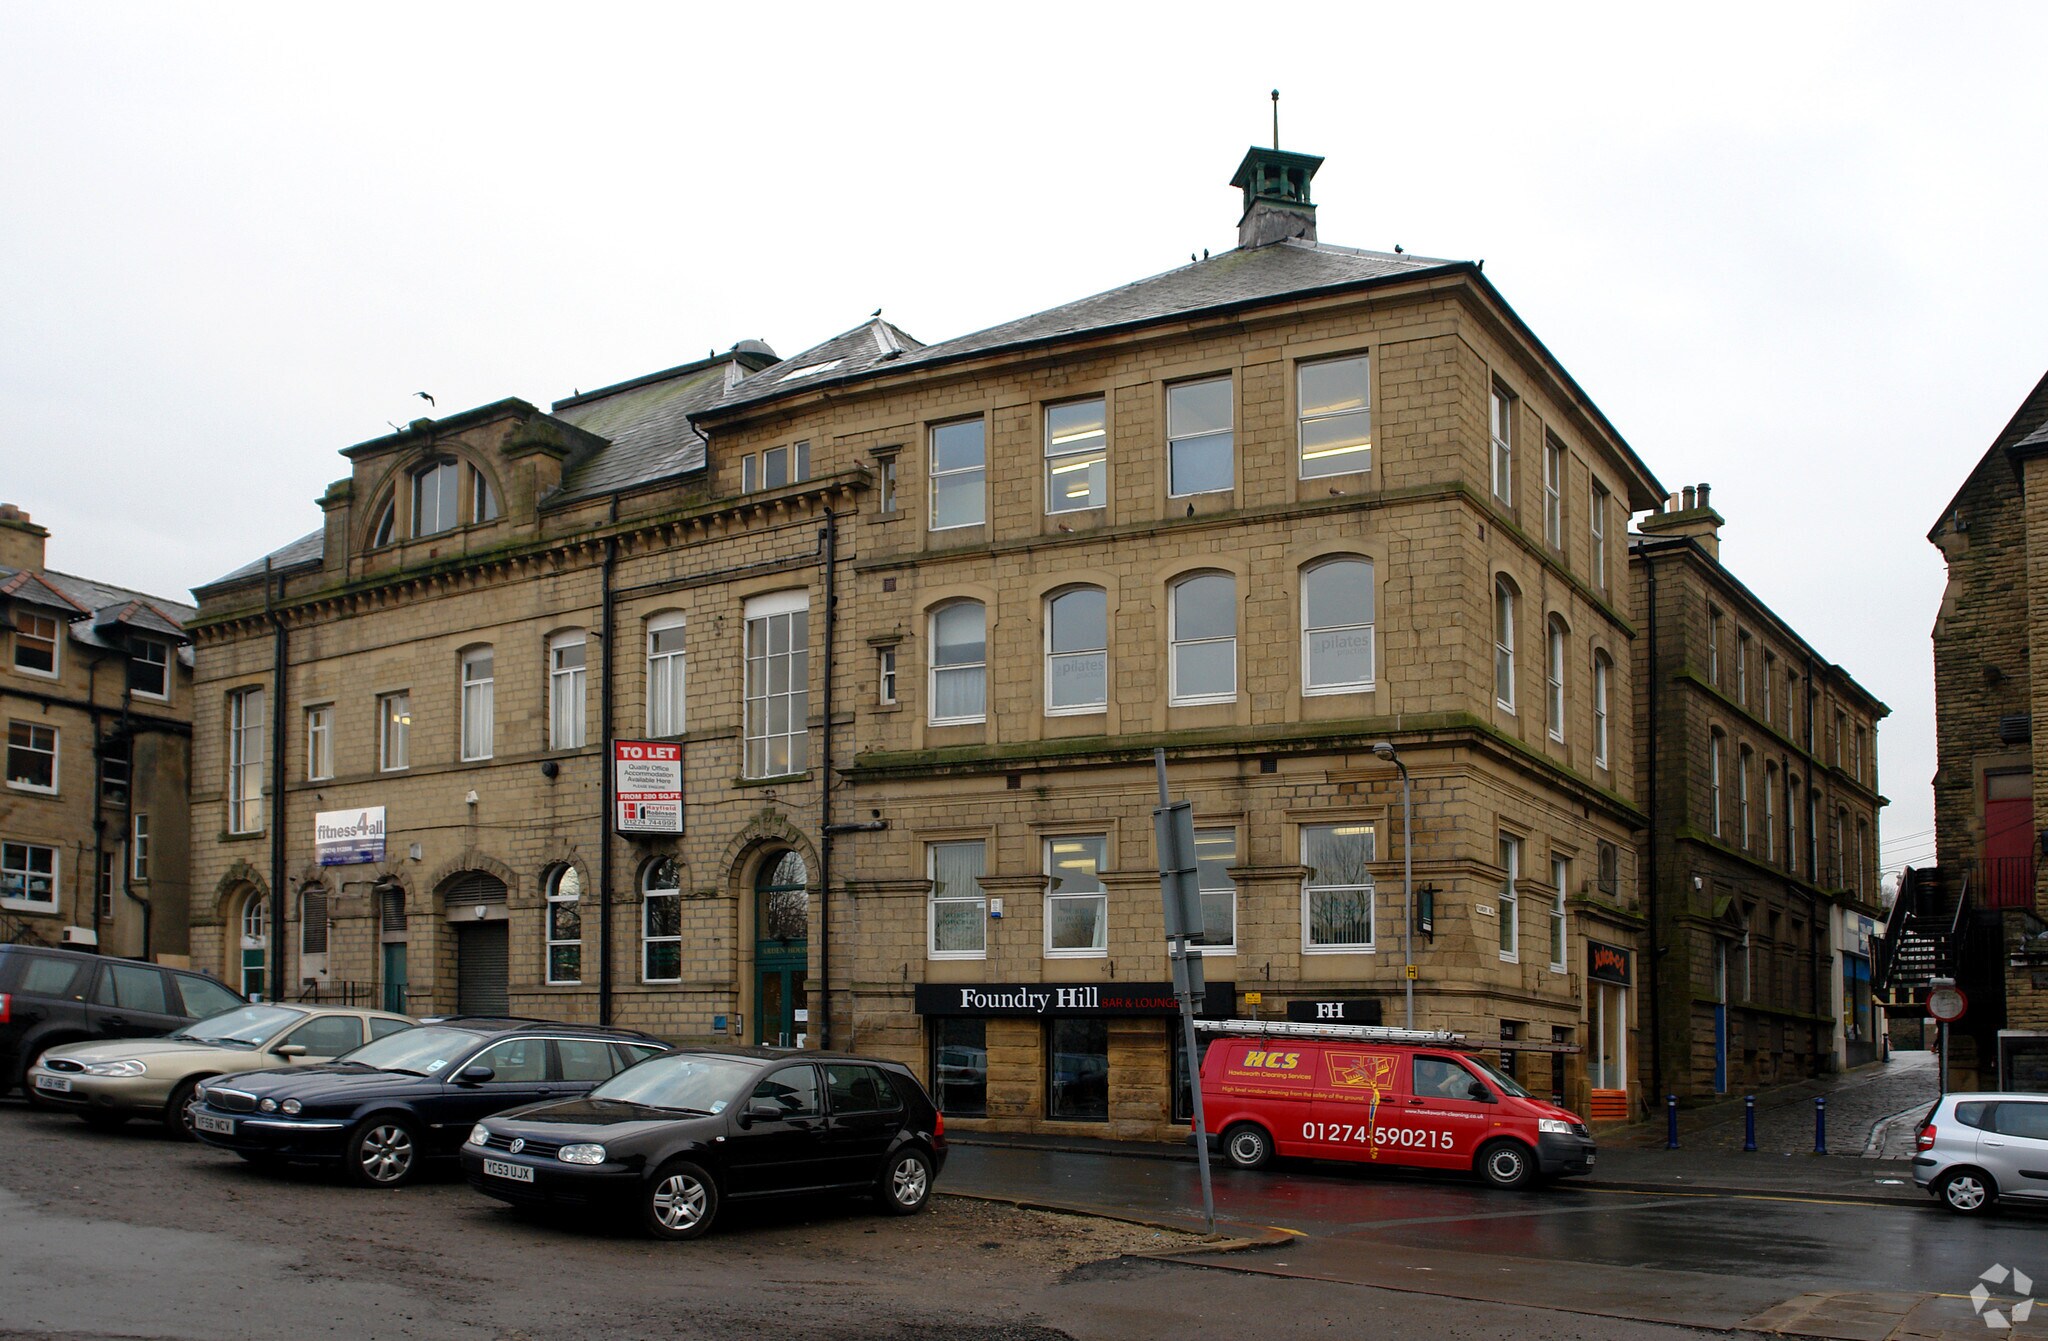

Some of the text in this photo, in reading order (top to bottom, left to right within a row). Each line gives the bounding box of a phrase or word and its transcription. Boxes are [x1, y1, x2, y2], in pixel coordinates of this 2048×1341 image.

[1321, 635, 1369, 653] pilates
[1062, 660, 1105, 676] pilates
[620, 746, 676, 759] TO LET
[624, 770, 674, 778] Accommodation
[628, 763, 650, 771] Quality
[317, 812, 383, 840] fitness4all
[1407, 966, 1416, 978] H
[960, 986, 1180, 1013] Foundry Hill BAR & LOUNGE
[1316, 1002, 1344, 1018] FH
[1243, 1051, 1300, 1069] HCS
[1228, 1069, 1260, 1077] Hawksworth
[1261, 1071, 1287, 1080] Cleaning
[1267, 1089, 1289, 1097] cleaning
[1404, 1108, 1484, 1119] www.hawksworth-cleaning.co.uk
[199, 1116, 230, 1133] YF56 NCV
[487, 1161, 529, 1180] YC53 UJX
